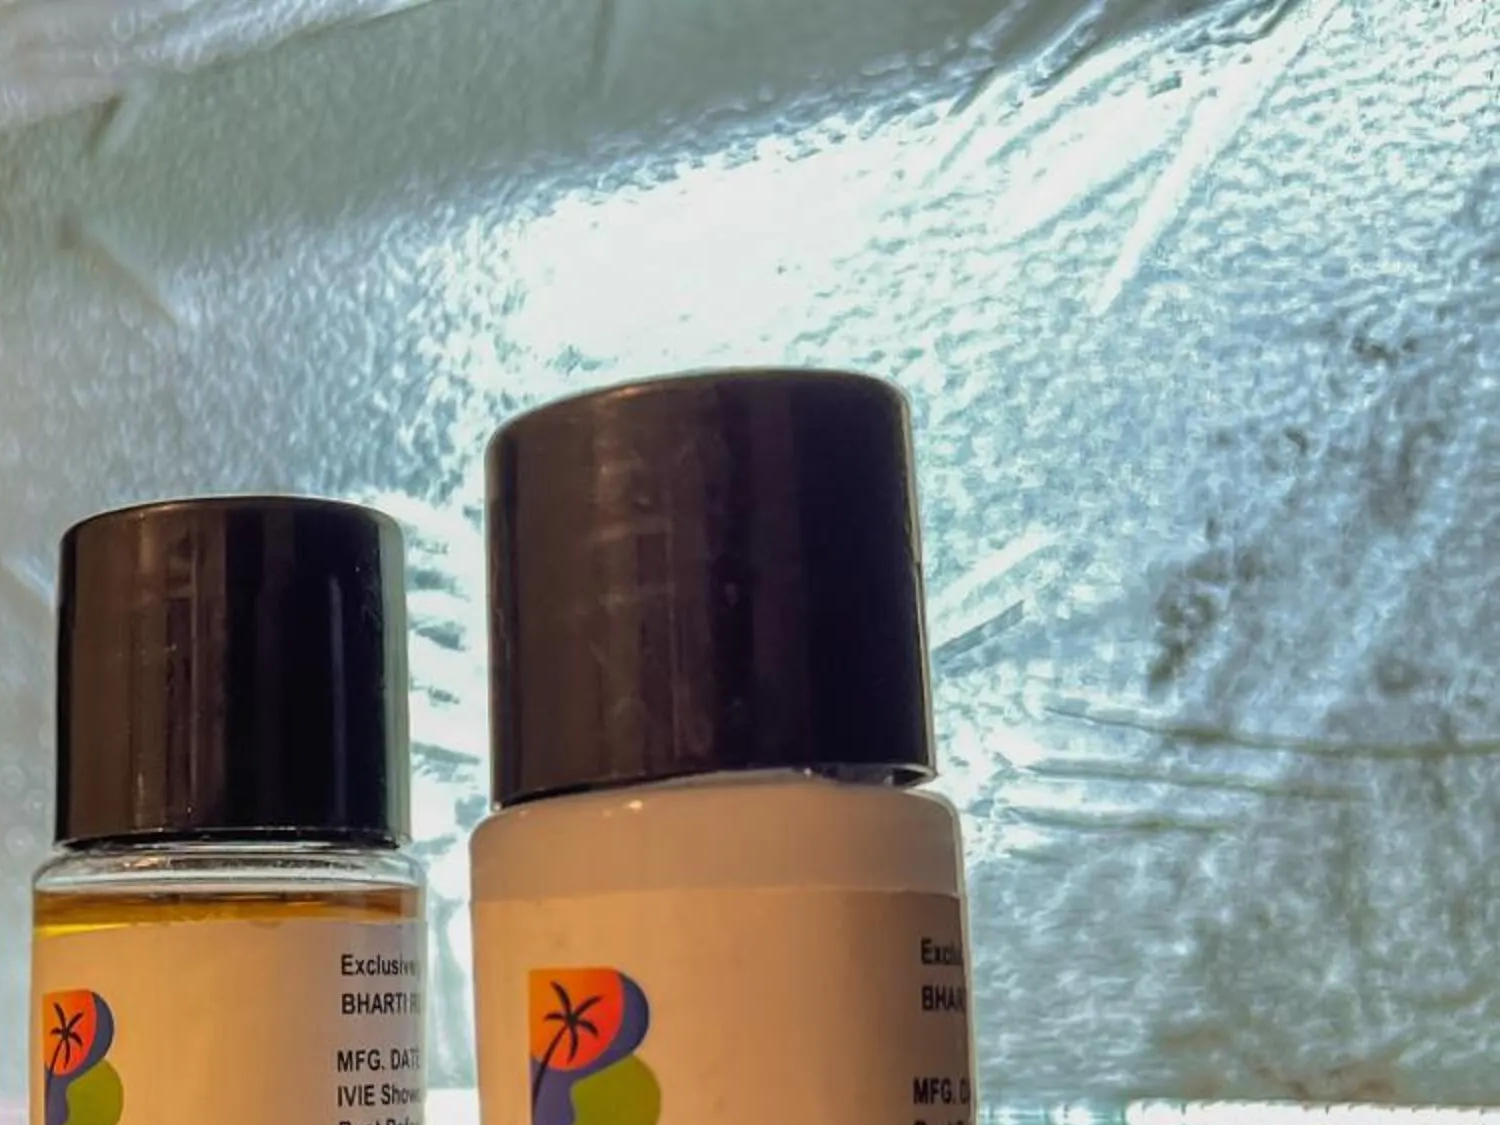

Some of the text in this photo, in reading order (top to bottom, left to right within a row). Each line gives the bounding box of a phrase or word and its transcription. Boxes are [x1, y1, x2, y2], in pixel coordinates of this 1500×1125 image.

[341, 992, 407, 1016] BHARTI
[337, 1048, 386, 1073] MFG.
[337, 1084, 376, 1108] IVIE
[912, 1076, 957, 1105] MFG.
